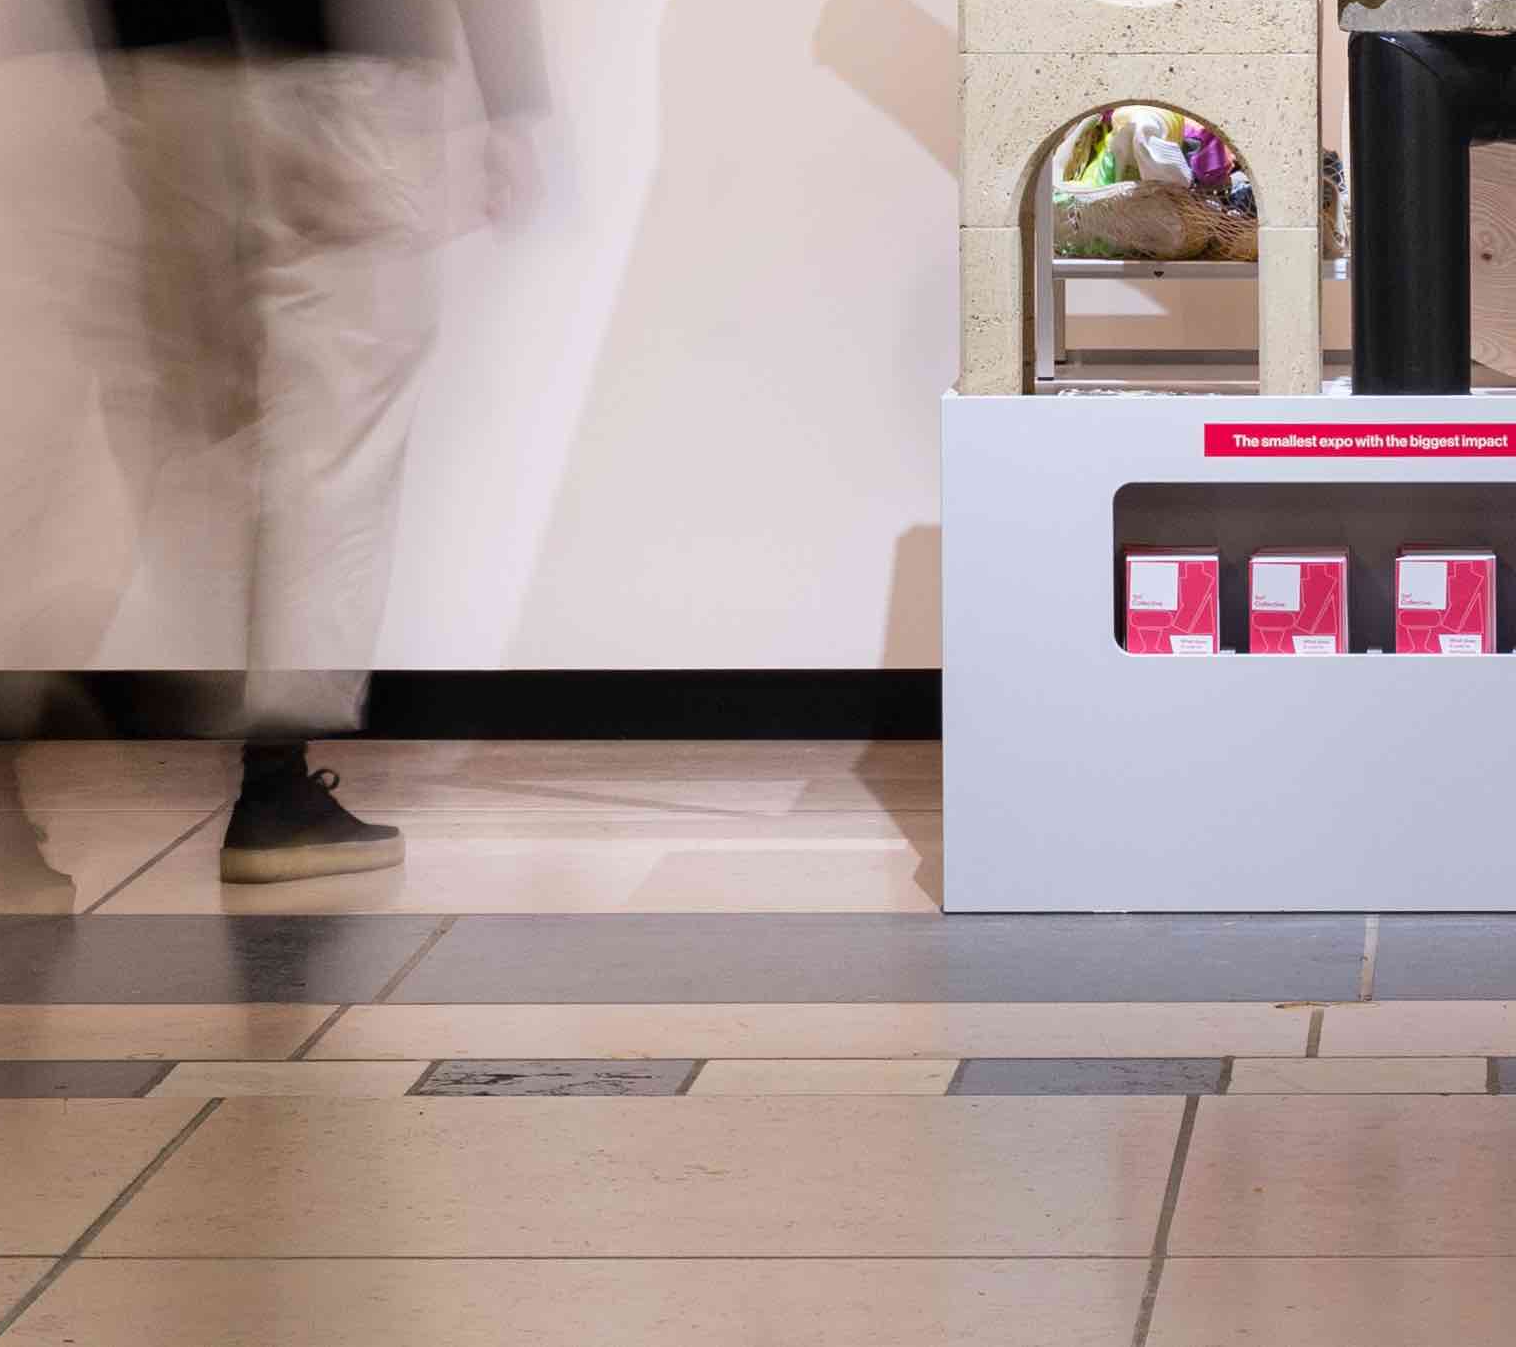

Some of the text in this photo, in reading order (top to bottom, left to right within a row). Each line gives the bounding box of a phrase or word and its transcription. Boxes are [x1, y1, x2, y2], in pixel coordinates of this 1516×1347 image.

[1232, 433, 1509, 450] The smallest expo with the biggest impact
